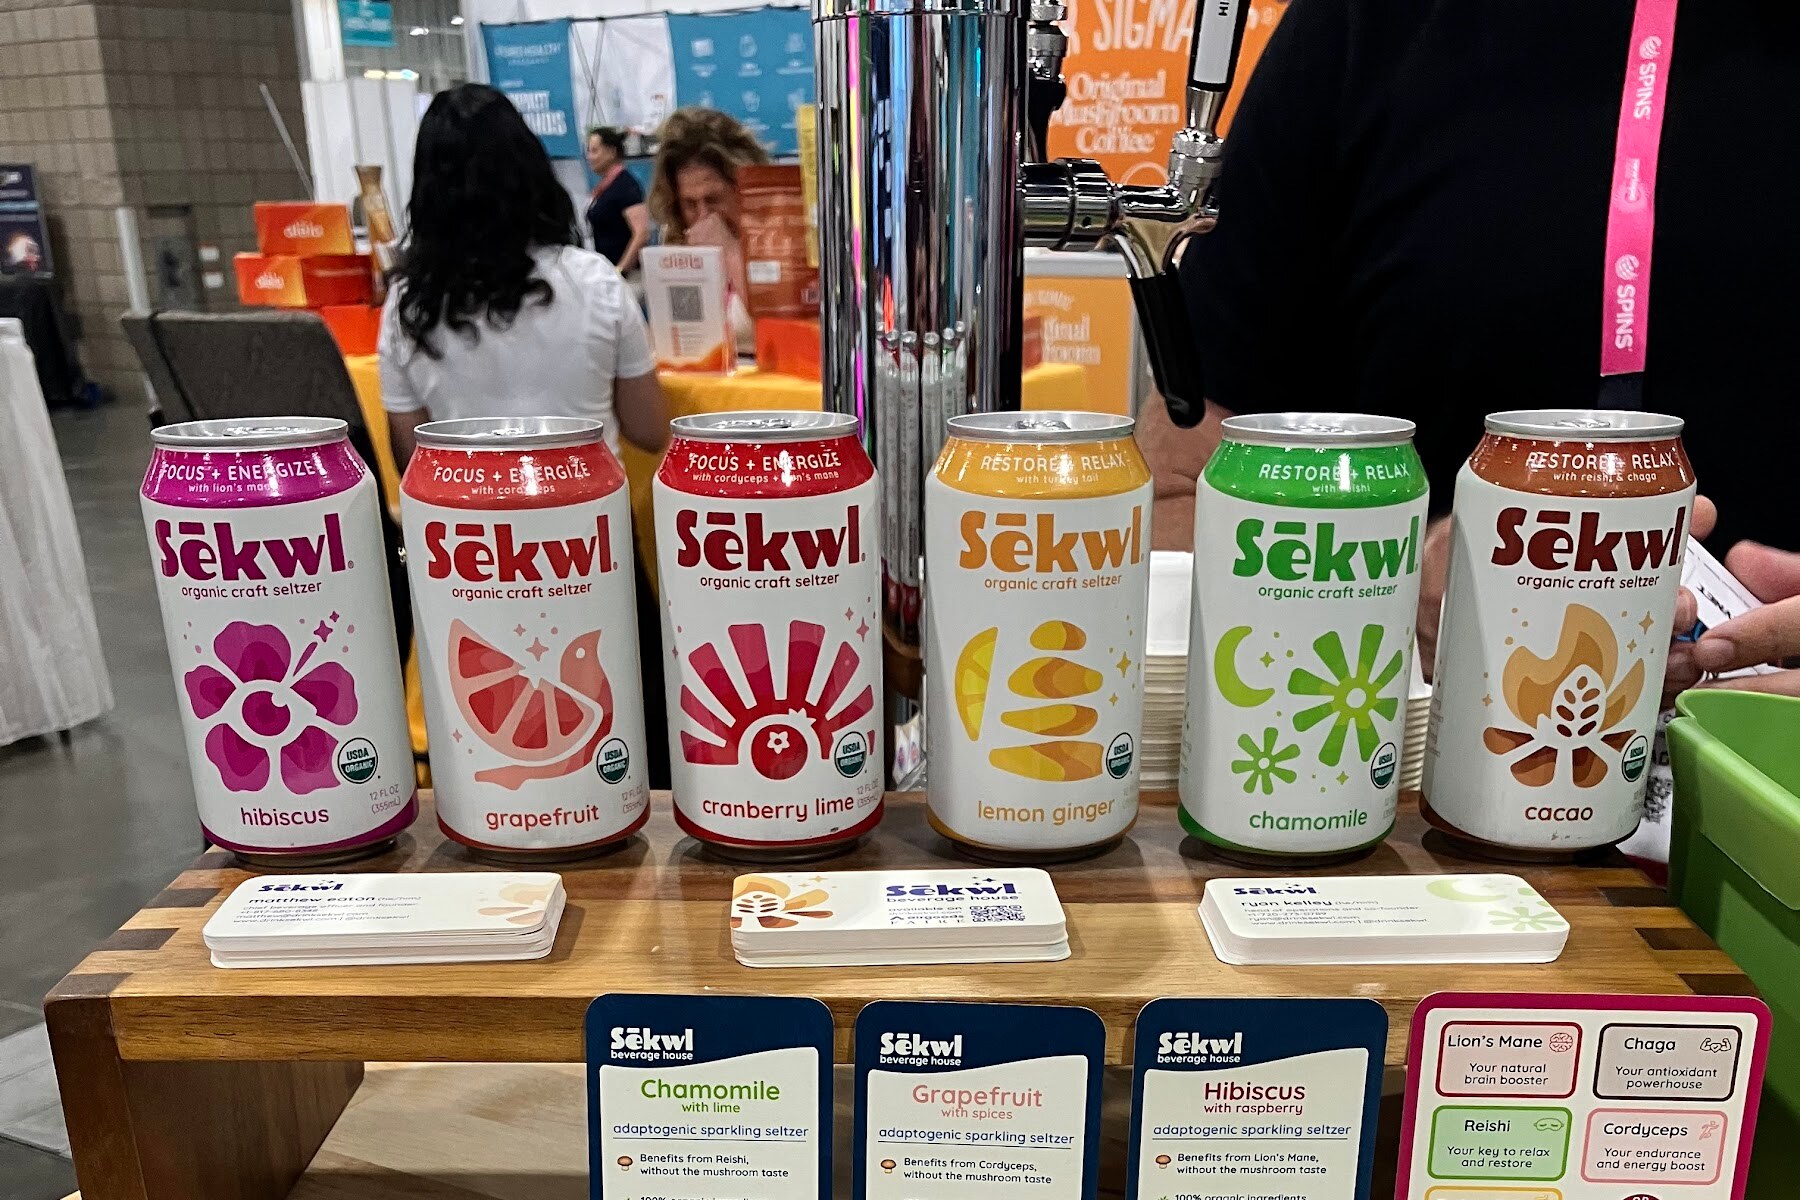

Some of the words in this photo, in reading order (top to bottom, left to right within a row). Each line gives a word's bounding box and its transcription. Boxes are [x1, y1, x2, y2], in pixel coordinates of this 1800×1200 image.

[1069, 68, 1166, 104] Original
[1633, 61, 1658, 120] SPINS
[1076, 126, 1155, 153] Coffee
[1614, 284, 1636, 349] SPINS
[689, 455, 739, 472] FOCUS
[980, 456, 1057, 472] RESTORE
[1082, 453, 1126, 469] RELAX
[1525, 451, 1610, 470] RESTORE
[1632, 451, 1675, 469] RELAX
[162, 463, 205, 481] FOCUS
[433, 467, 485, 483] FOCUS
[510, 462, 592, 483] EERGIZE
[692, 473, 711, 482] with
[714, 473, 769, 484] cordyceps
[814, 471, 839, 480] mane
[1259, 464, 1341, 481] RESTORE
[1366, 463, 1410, 480] RELAX
[1553, 471, 1577, 481] with
[1628, 472, 1657, 484] chaga
[700, 576, 750, 590] organic
[755, 576, 791, 589] craft
[795, 573, 839, 588] seltzer
[1517, 574, 1574, 590] organic
[1578, 573, 1615, 589] craft
[1619, 574, 1659, 589] seltzer
[182, 584, 228, 600] organic
[232, 584, 269, 598] craft
[273, 582, 322, 596] seltzer
[346, 748, 369, 761] USDA
[604, 748, 623, 761] USDA
[344, 760, 374, 774] ORGANIC
[602, 762, 627, 775] ORGANIC
[240, 807, 329, 826] hibiscus
[486, 804, 600, 831] grapefruit
[702, 799, 808, 823] cranberry
[816, 796, 854, 816] lime
[977, 801, 1044, 822] lemon
[1052, 799, 1115, 825] ginger
[1524, 806, 1593, 821] cacao
[1249, 809, 1368, 831] chamomile
[1447, 1035, 1494, 1048] Lion's
[1499, 1035, 1543, 1048] Mane
[1623, 1037, 1676, 1054] Chaga
[610, 1050, 660, 1061] beverage
[663, 1050, 693, 1061] house
[1469, 1062, 1496, 1074] Your
[1500, 1062, 1547, 1074] natural
[1464, 1074, 1497, 1086] brain
[1500, 1074, 1549, 1086] booster
[640, 1079, 780, 1101] Chamomile
[912, 1084, 1043, 1110] Grapefruit
[1204, 1081, 1306, 1101] Hibiscus
[682, 1102, 709, 1113] with
[713, 1102, 741, 1114] lime
[941, 1107, 968, 1119] with
[972, 1108, 1013, 1121] spices
[1204, 1102, 1232, 1114] with
[1236, 1104, 1304, 1116] raspberry
[613, 1123, 697, 1136] adaptogenic
[700, 1124, 761, 1138] sparkling
[765, 1125, 808, 1137] seltzer
[1153, 1124, 1238, 1136] adaptogenic
[1241, 1124, 1303, 1137] sparkling
[1306, 1124, 1351, 1136] seltzer
[1464, 1118, 1511, 1133] Reishi
[1603, 1122, 1688, 1139] Cordyceps
[640, 1153, 684, 1164] Benefits
[687, 1154, 713, 1164] from
[716, 1155, 749, 1166] Reishi,
[1448, 1145, 1474, 1157] Your
[1478, 1146, 1499, 1159] key
[1503, 1147, 1516, 1157] to
[1519, 1146, 1550, 1158] relax
[904, 1157, 948, 1168] Benefits
[950, 1159, 976, 1169] from
[979, 1160, 1037, 1173] Cordyceps,
[1461, 1157, 1485, 1168] and
[1488, 1158, 1532, 1168] restore
[640, 1166, 680, 1177] without
[682, 1167, 700, 1177] the
[703, 1168, 759, 1177] mushroom
[762, 1169, 789, 1178] taste
